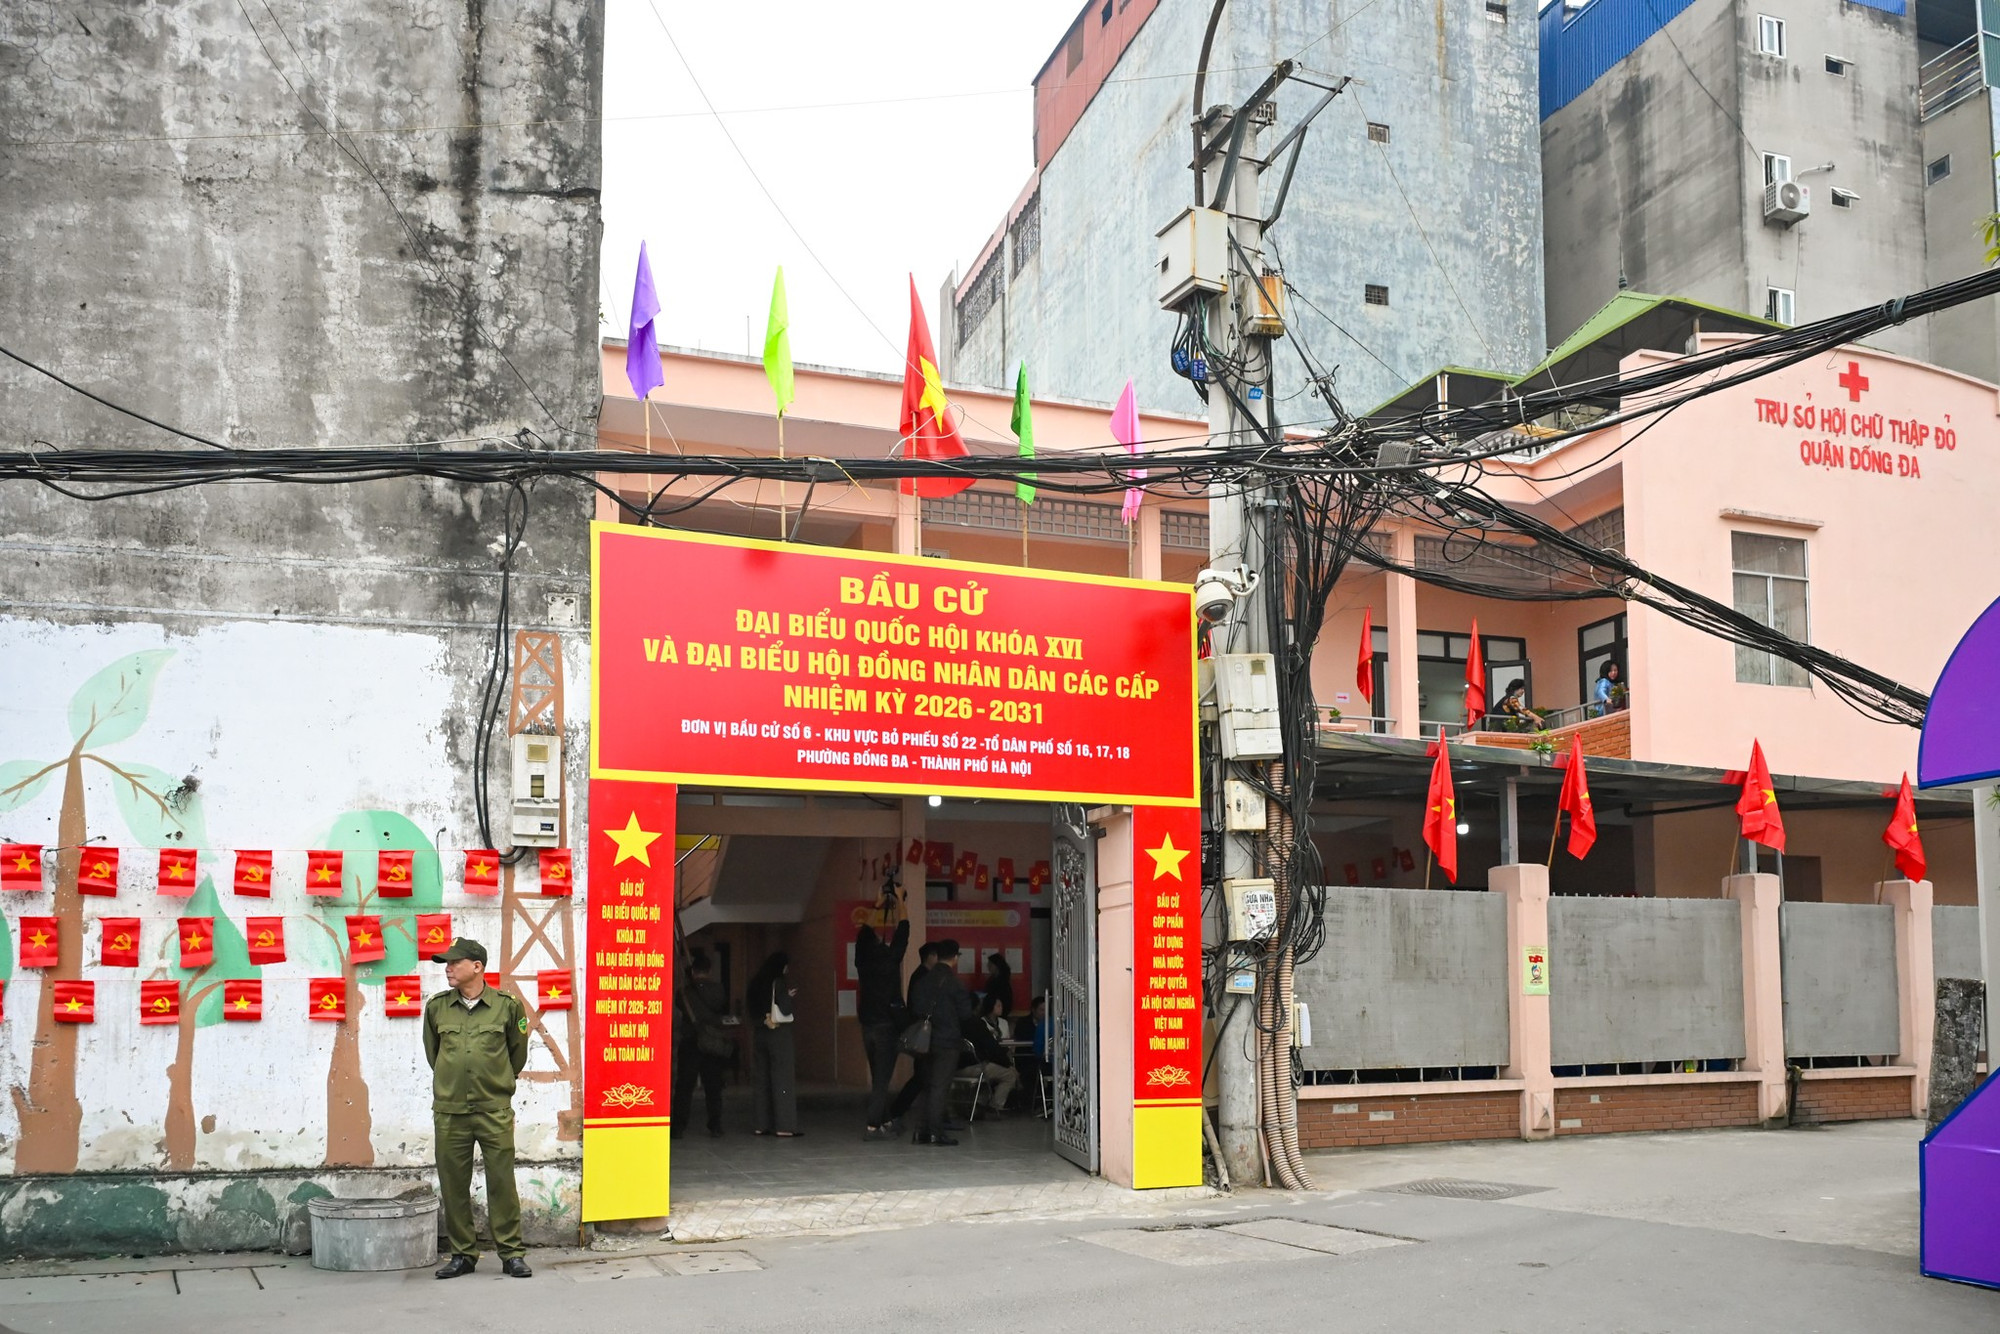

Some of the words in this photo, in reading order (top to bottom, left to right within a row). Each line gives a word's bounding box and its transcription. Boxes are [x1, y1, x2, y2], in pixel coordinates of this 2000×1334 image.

[1754, 397, 1788, 428] TRỤ
[1793, 392, 1816, 430] SỞ
[1820, 408, 1847, 438] HỘI
[1851, 412, 1884, 439] CHỮ
[1889, 419, 1929, 448] THẬP
[1934, 413, 1956, 451] ĐỎ
[1799, 439, 1844, 471] QUẬN
[1850, 445, 1893, 475] ĐỐNG
[1898, 453, 1921, 479] ĐA
[840, 571, 919, 609] BẦU
[934, 581, 988, 615] CỬ
[736, 609, 779, 638] ĐẠI
[789, 608, 846, 639] BIỂU
[855, 616, 920, 646] QUỐC
[929, 623, 967, 654] HỘI
[976, 629, 1038, 656] KHÓA
[1045, 636, 1083, 660] XVI
[643, 635, 678, 663] VÀ
[686, 642, 731, 672] ĐẠI
[741, 640, 799, 672] BIỂU
[808, 649, 849, 680] HỘI
[858, 650, 925, 682] ĐỒNG
[934, 660, 1000, 687] NHÂN
[1009, 665, 1055, 692] DÂN
[1064, 670, 1108, 696] CÁC
[1116, 672, 1159, 699] CẤP
[784, 684, 866, 715] NHIỆM
[876, 688, 906, 714] KỲ
[681, 719, 710, 734] ĐƠN
[714, 721, 726, 738] VỊ
[731, 719, 757, 737] BẦU
[761, 721, 780, 738] CỬ
[783, 722, 800, 739] SỐ
[803, 726, 811, 739] 6
[825, 728, 850, 742] KHU
[854, 729, 878, 745] VỰC
[882, 728, 898, 745] BỎ
[903, 731, 938, 747] PHIẾU
[942, 732, 958, 748] SỐ
[962, 737, 976, 749] 22
[1002, 737, 1026, 752] DÂN
[1030, 738, 1053, 754] PHỐ
[1057, 740, 1072, 755] SỐ
[1076, 744, 1092, 758] 16,
[1096, 746, 1113, 759] 17,
[1117, 747, 1129, 759] 18
[798, 748, 850, 765] PHƯỜNG
[853, 749, 888, 766] ĐỐNG
[891, 755, 908, 767] ĐA
[920, 755, 960, 770] THÀNH
[964, 756, 988, 772] PHỐ
[992, 758, 1007, 773] HÀ
[1011, 760, 1031, 777] NỘI
[635, 879, 644, 896] CỬ
[1171, 893, 1179, 908] CỬ
[602, 905, 613, 922] ĐẠI
[615, 901, 629, 919] BIỂU
[631, 902, 648, 921] QUỐC
[649, 904, 660, 923] HỘI
[1153, 914, 1165, 928] GÓP
[617, 927, 633, 943] KHÓA
[635, 930, 646, 943] XVI
[1154, 934, 1165, 948] XÂY
[1167, 936, 1183, 951] DỰNG
[596, 950, 604, 966] VÀ
[606, 952, 617, 969] ĐẠI
[619, 948, 633, 967] BIỂU
[635, 951, 645, 969] HỘI
[1153, 955, 1166, 968] NHÀ
[1167, 955, 1183, 968] NƯỚC
[599, 974, 617, 990] NHÂN
[619, 974, 632, 990] DÂN
[634, 974, 646, 990] CÁC
[648, 973, 661, 991] CẤP
[1150, 977, 1166, 988] PHÁP
[596, 998, 617, 1016] NHIỆM
[619, 998, 627, 1014] KỲ
[1142, 995, 1150, 1009] XÃ
[1151, 995, 1162, 1011] HỘI
[1163, 994, 1175, 1009] CHỦ
[1177, 995, 1195, 1009] NGHĨA
[610, 1024, 618, 1038] LÀ
[619, 1021, 636, 1037] NGÀY
[638, 1021, 648, 1040] HỘI
[1154, 1015, 1167, 1032] VIỆT
[1169, 1018, 1182, 1029] NAM
[604, 1043, 617, 1061] CỦA
[618, 1045, 635, 1061] TOÀN
[637, 1045, 649, 1061] DÂN
[1150, 1036, 1166, 1050] VỮNG
[1167, 1038, 1185, 1052] MẠNH
